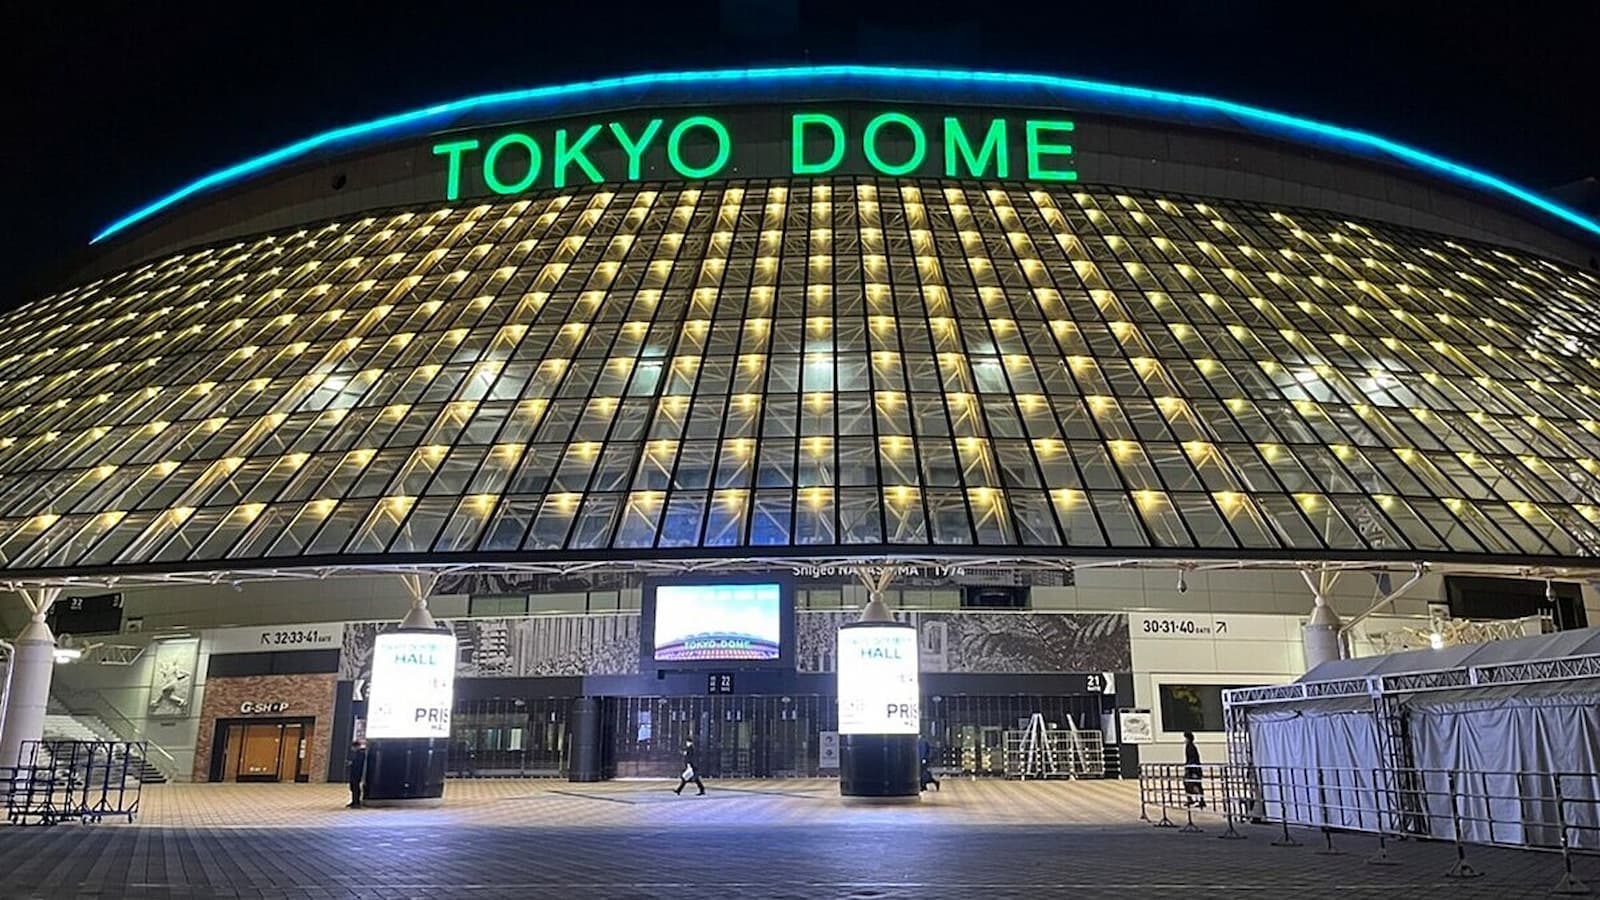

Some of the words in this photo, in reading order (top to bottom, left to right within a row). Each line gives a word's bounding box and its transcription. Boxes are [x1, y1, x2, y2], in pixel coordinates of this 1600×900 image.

[432, 115, 731, 200] TOKYO
[791, 113, 1078, 181] DOME
[394, 653, 437, 665] HALL
[861, 647, 903, 660] HALL
[1087, 674, 1100, 687] 21
